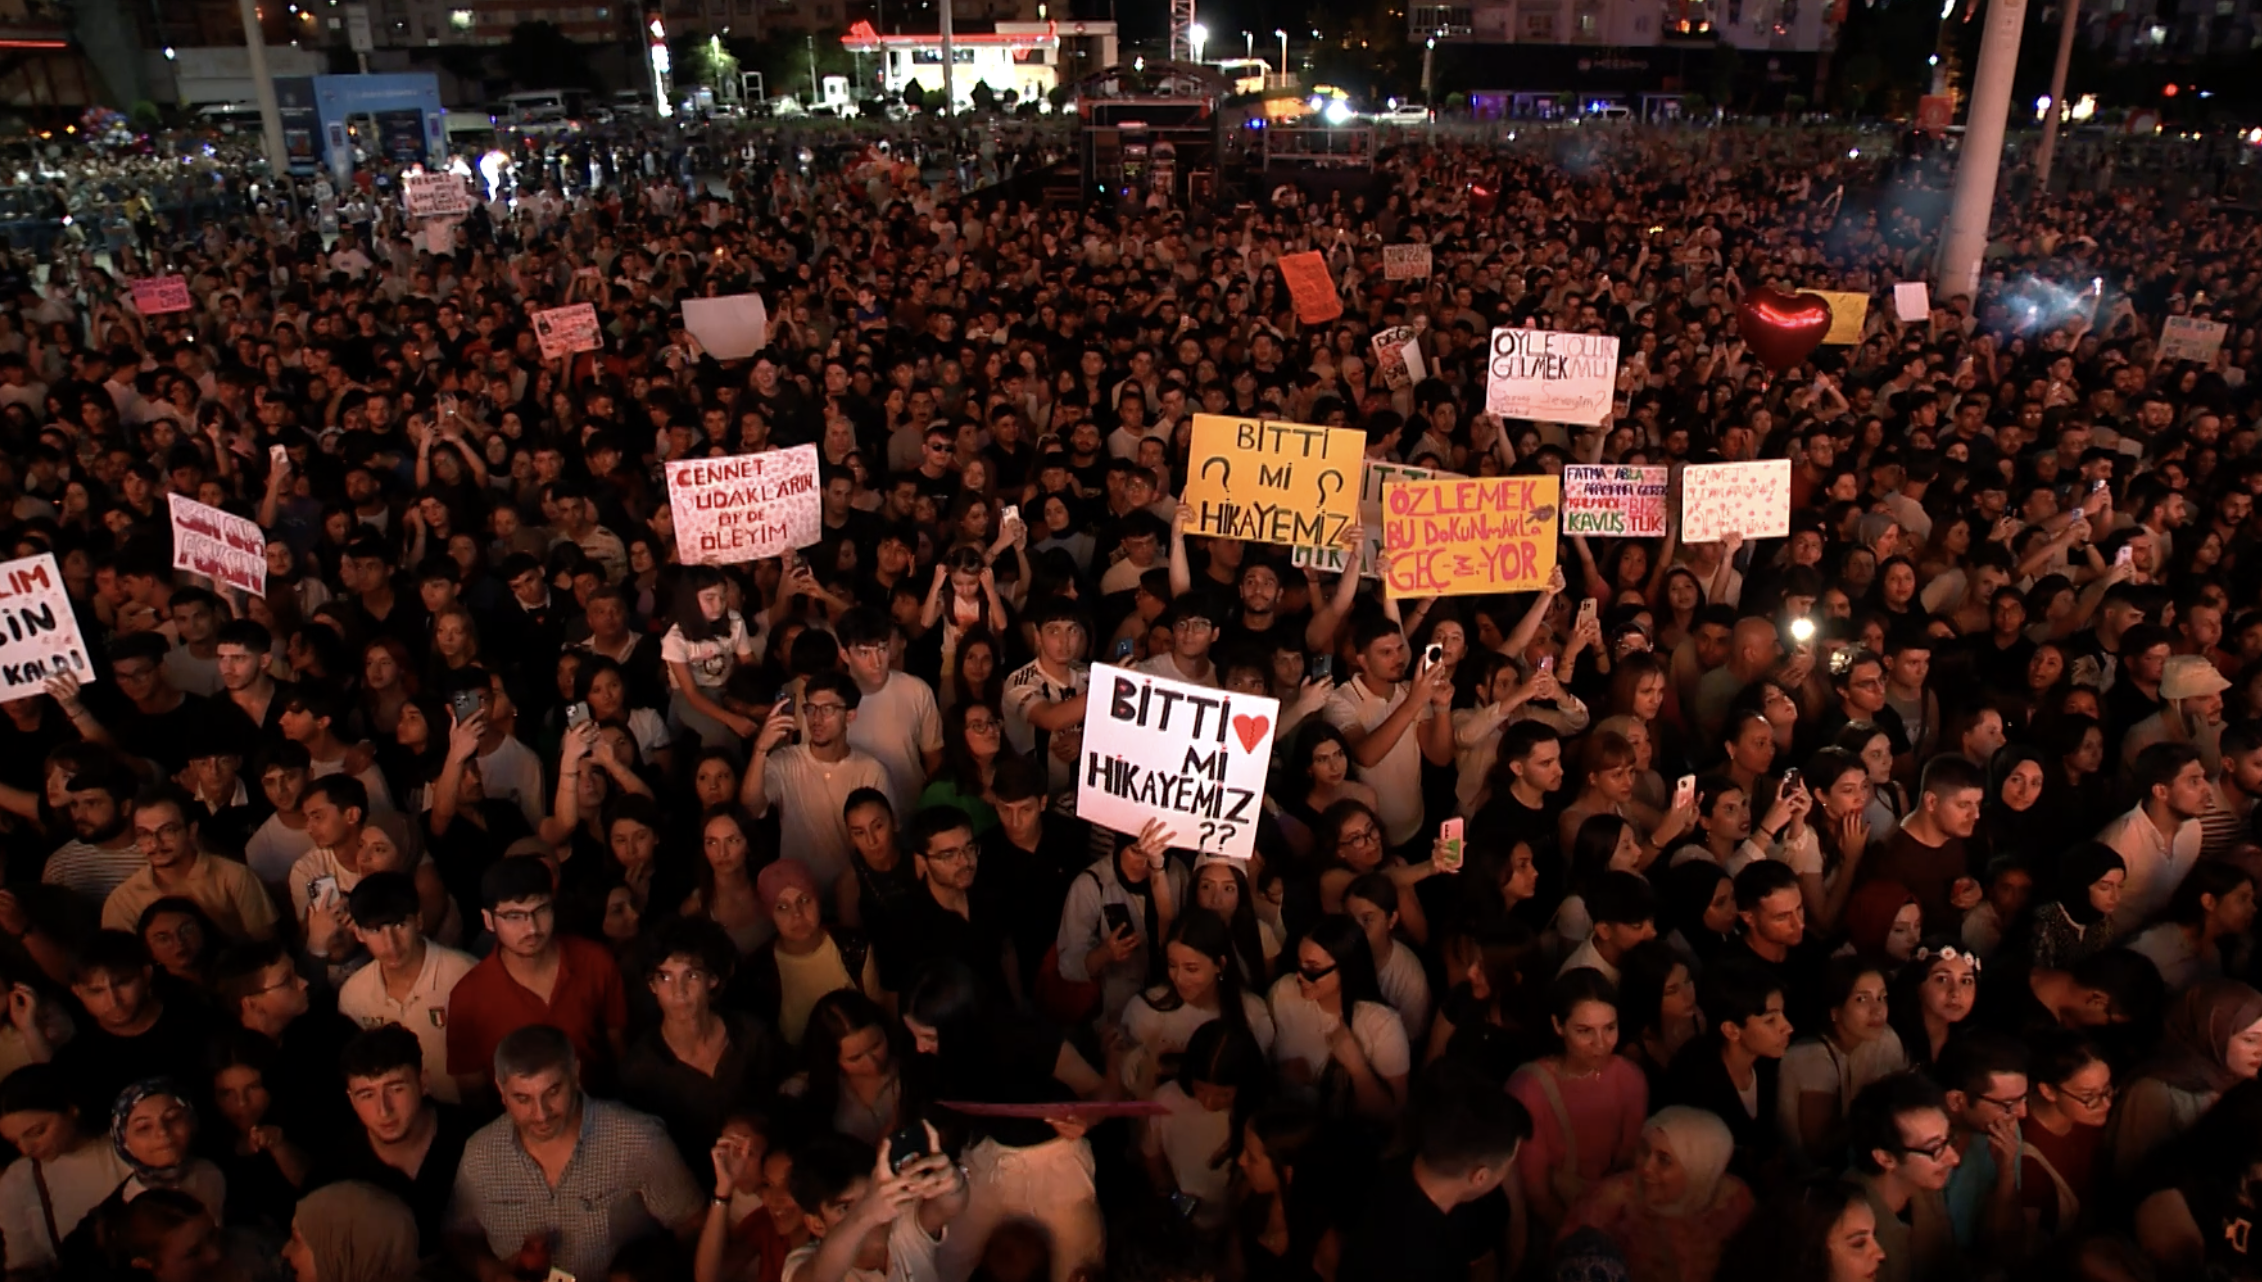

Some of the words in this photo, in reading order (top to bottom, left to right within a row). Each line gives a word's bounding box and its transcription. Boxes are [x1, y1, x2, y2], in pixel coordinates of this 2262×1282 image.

[676, 458, 765, 488] CENNET
[1259, 462, 1292, 490] Mİ
[1566, 467, 1607, 480] FATMA
[1614, 467, 1645, 481] ABLA
[1389, 480, 1537, 517] ÖZLEMEK
[1386, 519, 1416, 552] BU
[1110, 675, 1231, 744] BİTTİ
[1181, 744, 1229, 783] Mİ
[1087, 750, 1256, 824] HİKAYEMİZ
